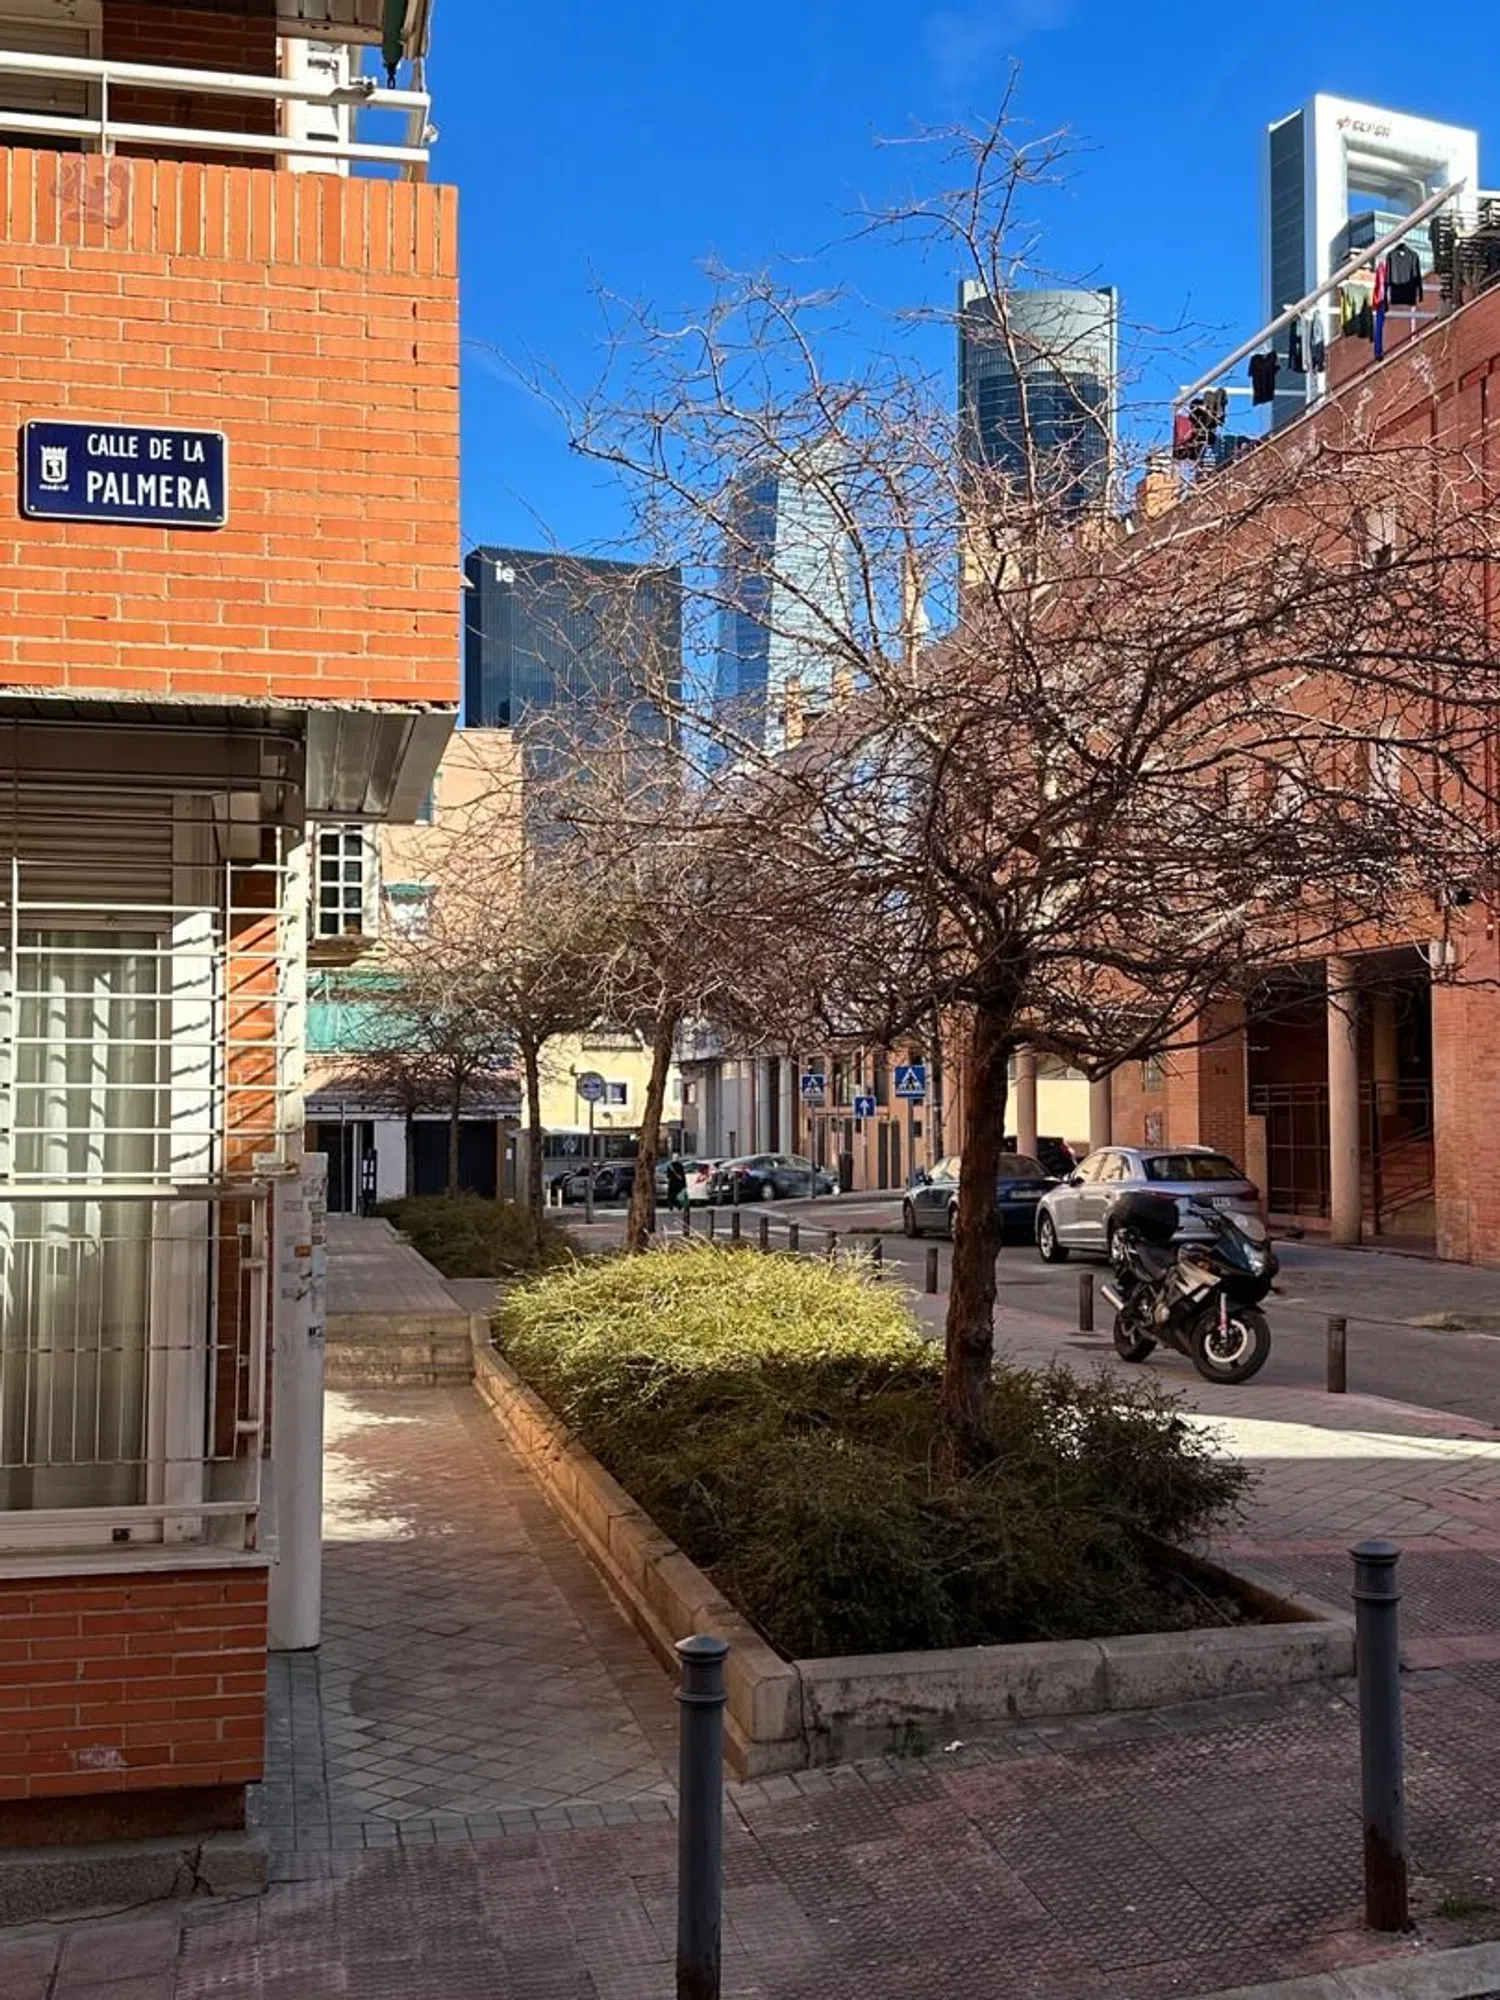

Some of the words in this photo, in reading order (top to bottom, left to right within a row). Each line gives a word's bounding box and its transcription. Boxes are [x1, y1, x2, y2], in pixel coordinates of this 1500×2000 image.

[87, 433, 139, 459] CALLE
[149, 437, 173, 460] DE
[183, 439, 205, 462] LA
[86, 471, 211, 510] PALMERA
[495, 560, 515, 583] ie
